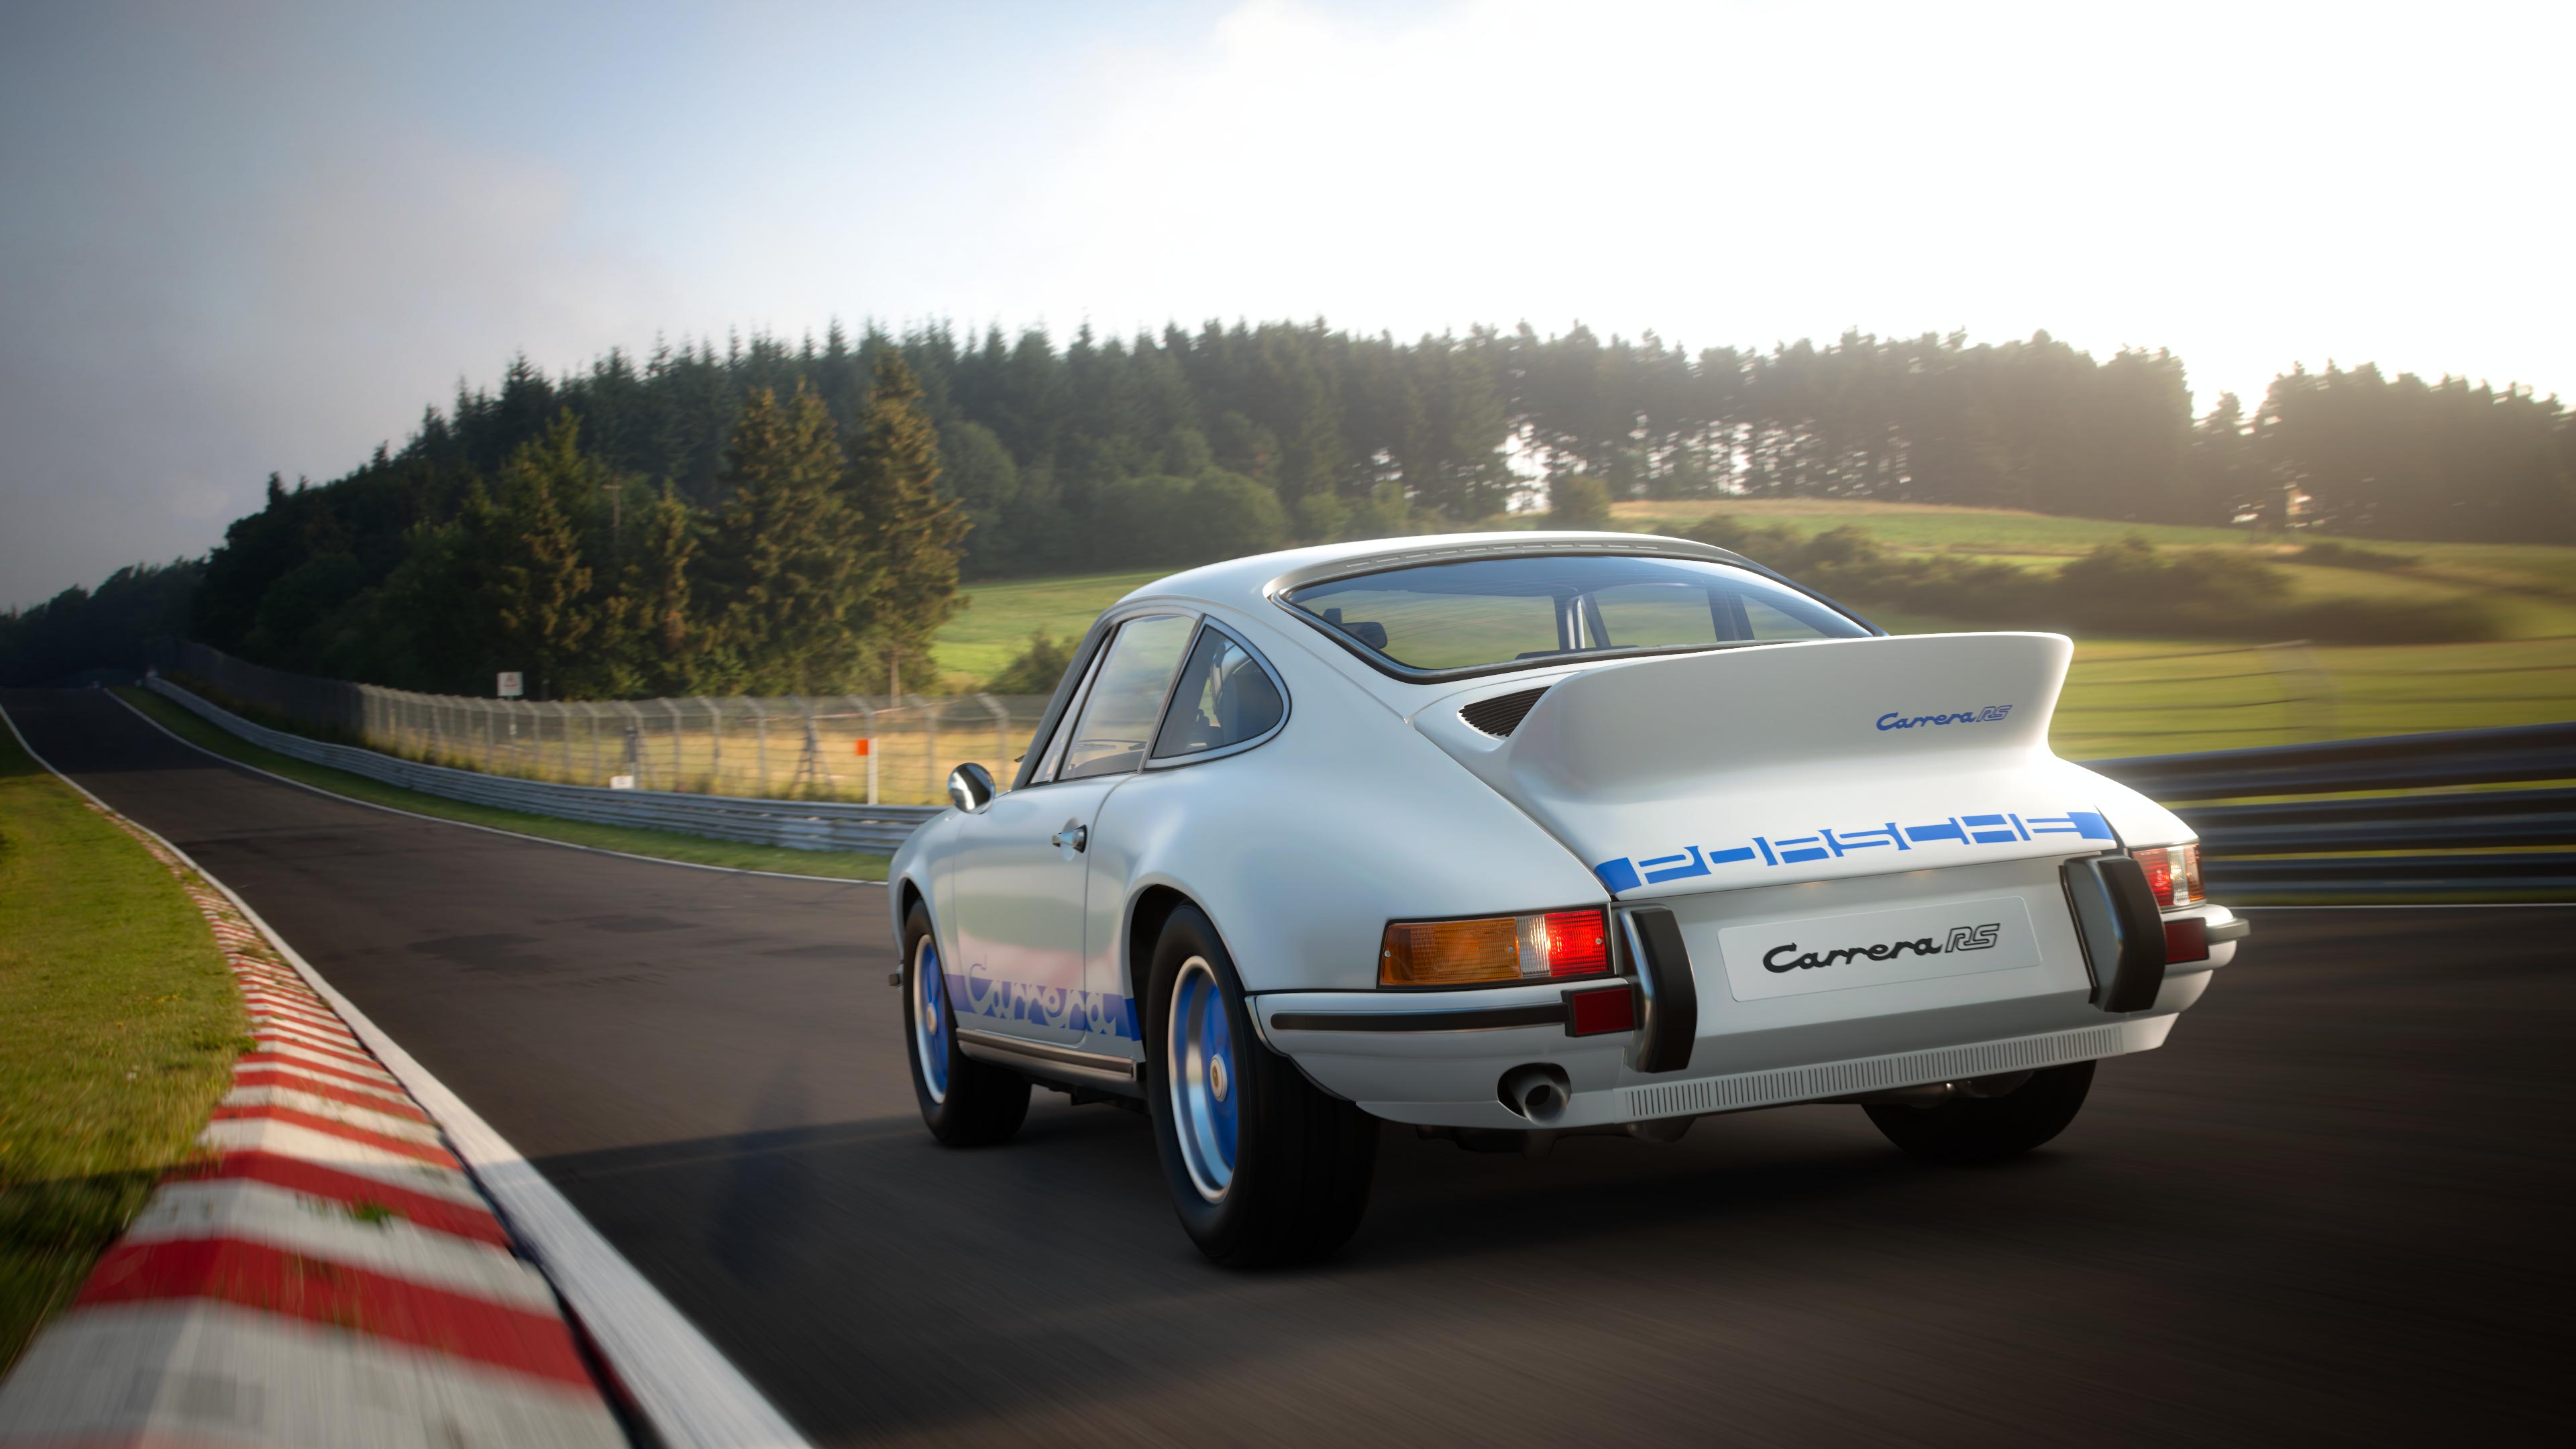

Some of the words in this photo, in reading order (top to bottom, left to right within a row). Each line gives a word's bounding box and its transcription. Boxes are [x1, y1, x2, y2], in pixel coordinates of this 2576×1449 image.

[1876, 711, 1977, 731] Carrera
[1976, 704, 2012, 722] RS
[1626, 811, 2084, 888] PORSCHE
[1762, 938, 1943, 973] Carrera
[1945, 923, 2000, 953] RS
[964, 955, 1116, 1036] Carrera
